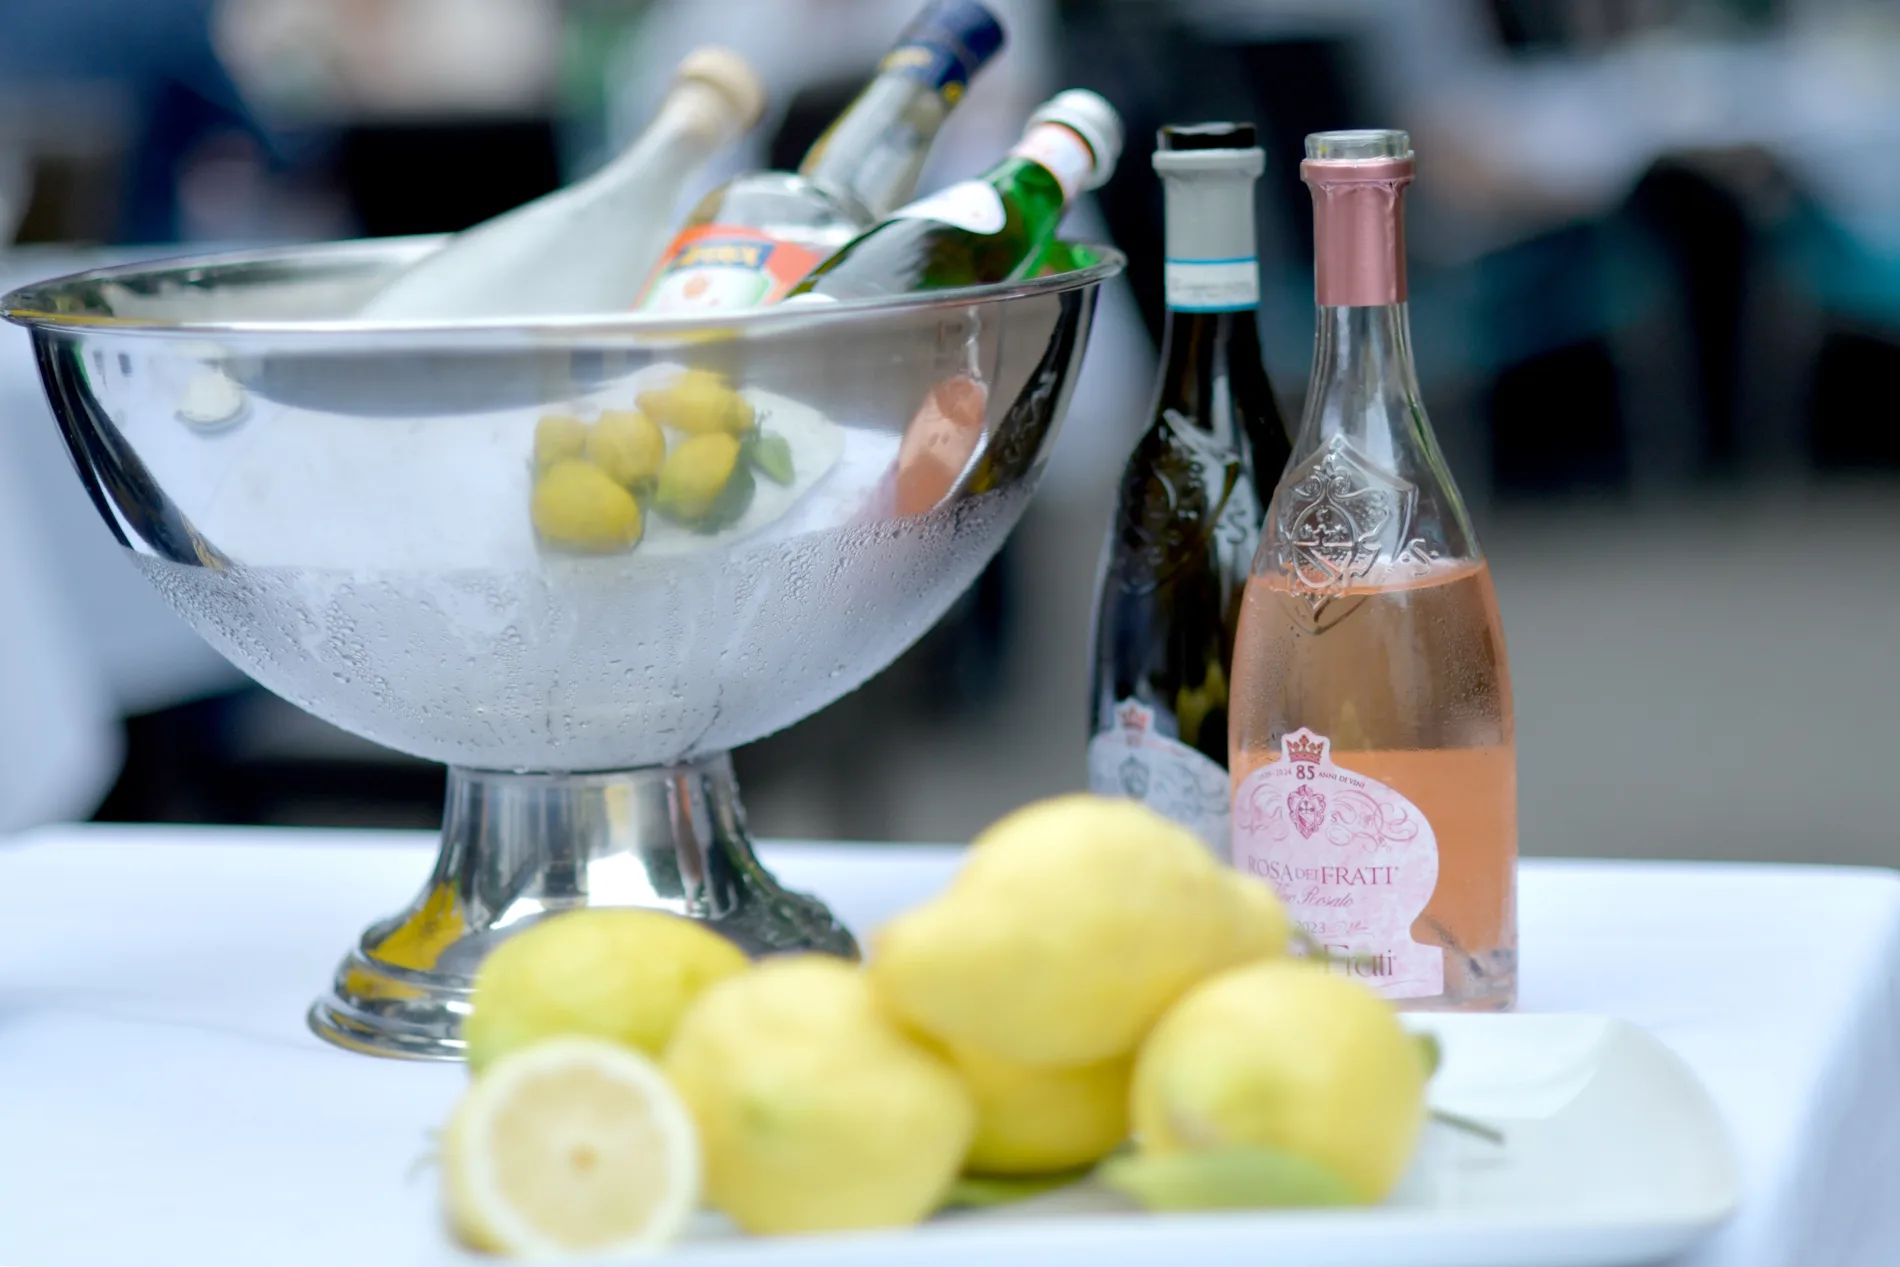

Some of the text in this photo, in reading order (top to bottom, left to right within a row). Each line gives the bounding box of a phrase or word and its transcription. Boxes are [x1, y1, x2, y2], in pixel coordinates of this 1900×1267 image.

[1296, 764, 1315, 780] 85
[1318, 771, 1338, 781] ANNI
[1350, 778, 1366, 789] VINI
[1248, 855, 1293, 881] ROSA
[1321, 866, 1393, 885] FRATI
